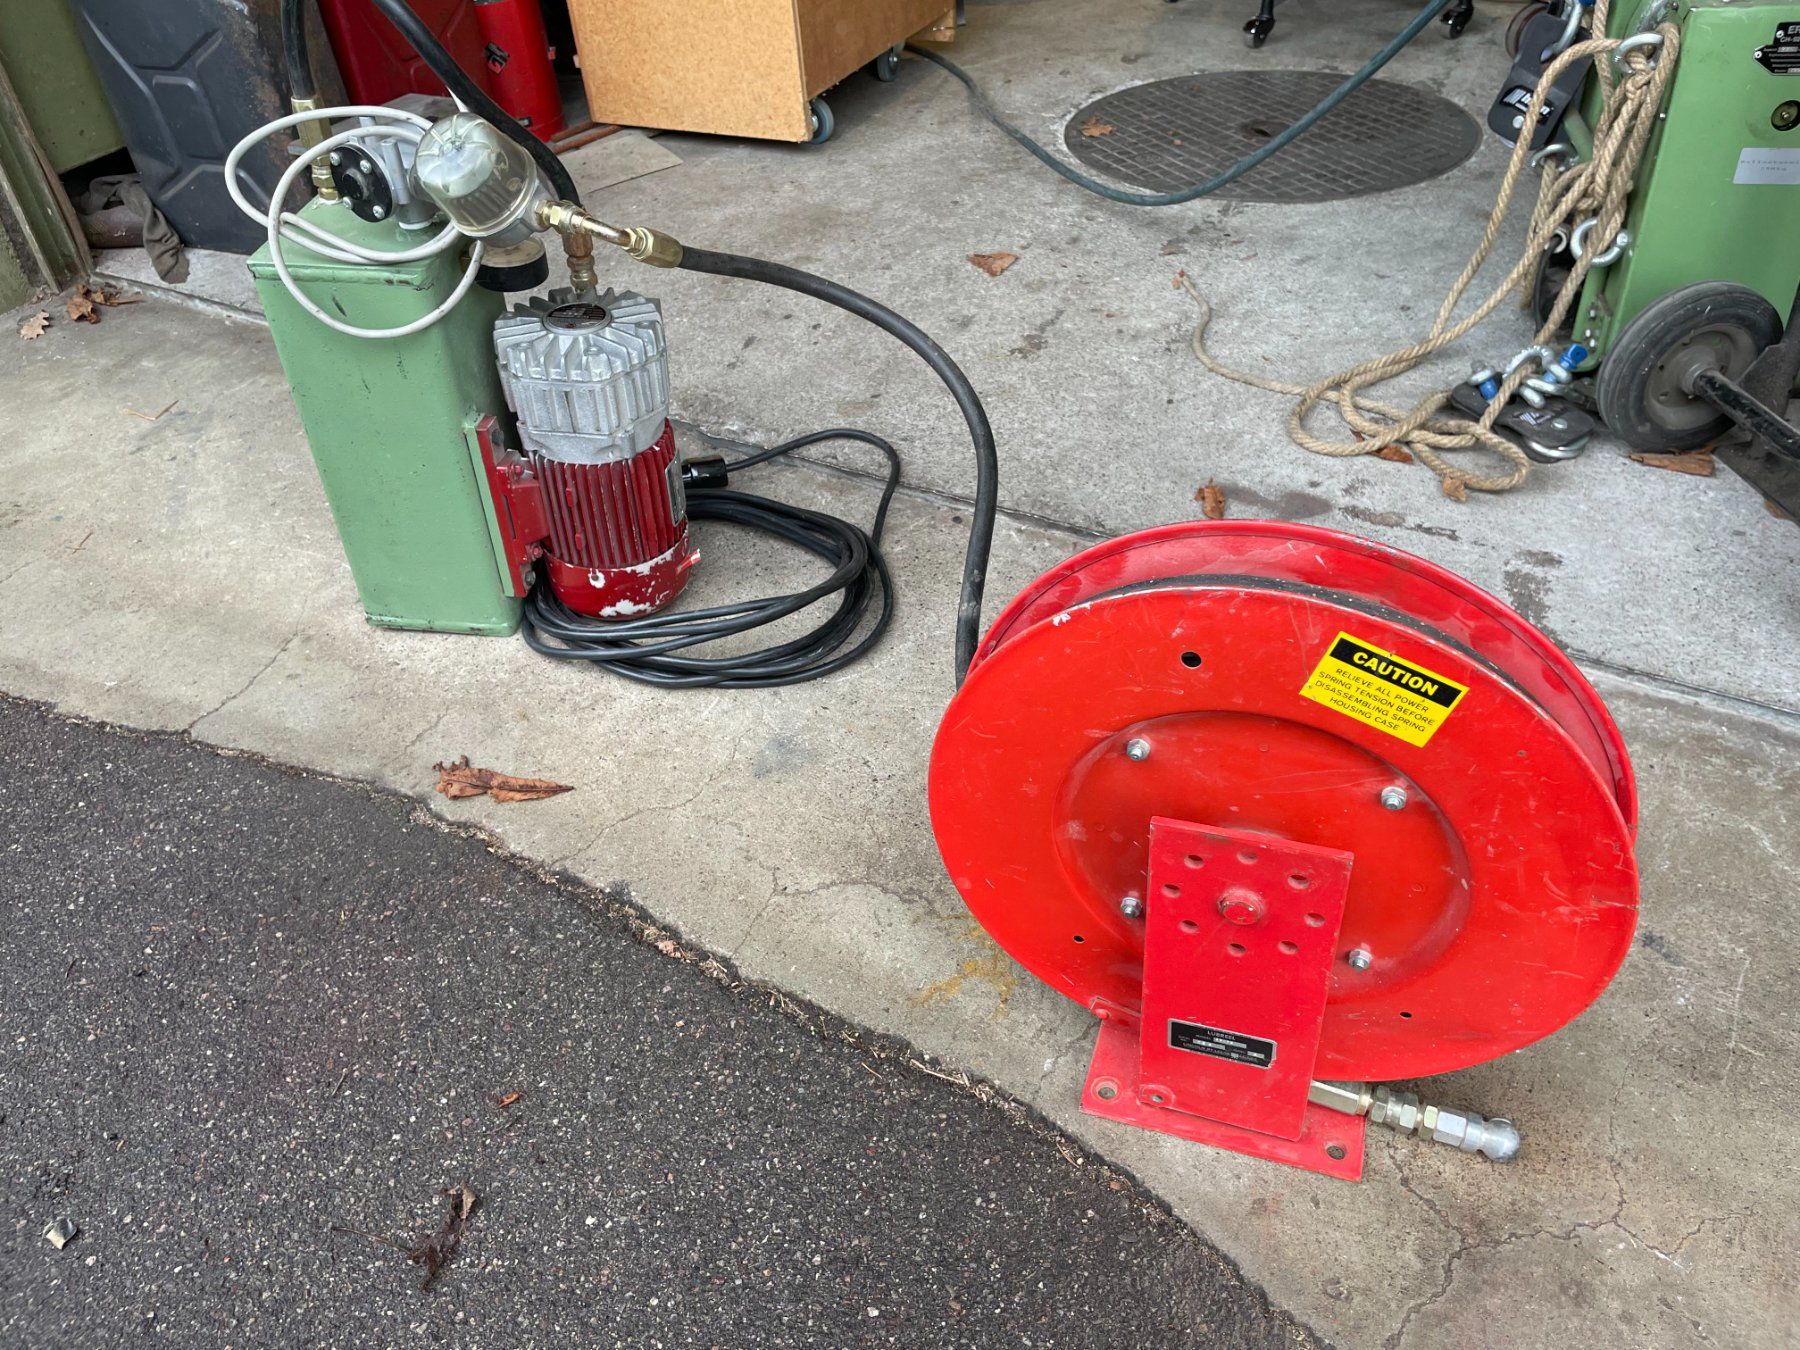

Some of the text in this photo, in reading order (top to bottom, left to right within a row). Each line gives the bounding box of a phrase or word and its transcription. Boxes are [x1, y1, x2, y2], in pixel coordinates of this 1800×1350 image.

[1336, 668, 1429, 712] RELIEVE ALL POWER
[1353, 651, 1439, 696] CAUTION
[1315, 680, 1426, 732] DISASSEMBLING SPRING
[1318, 671, 1435, 726] SPRING TENSION BEFORE
[1330, 697, 1401, 731] HOUSING CASE
